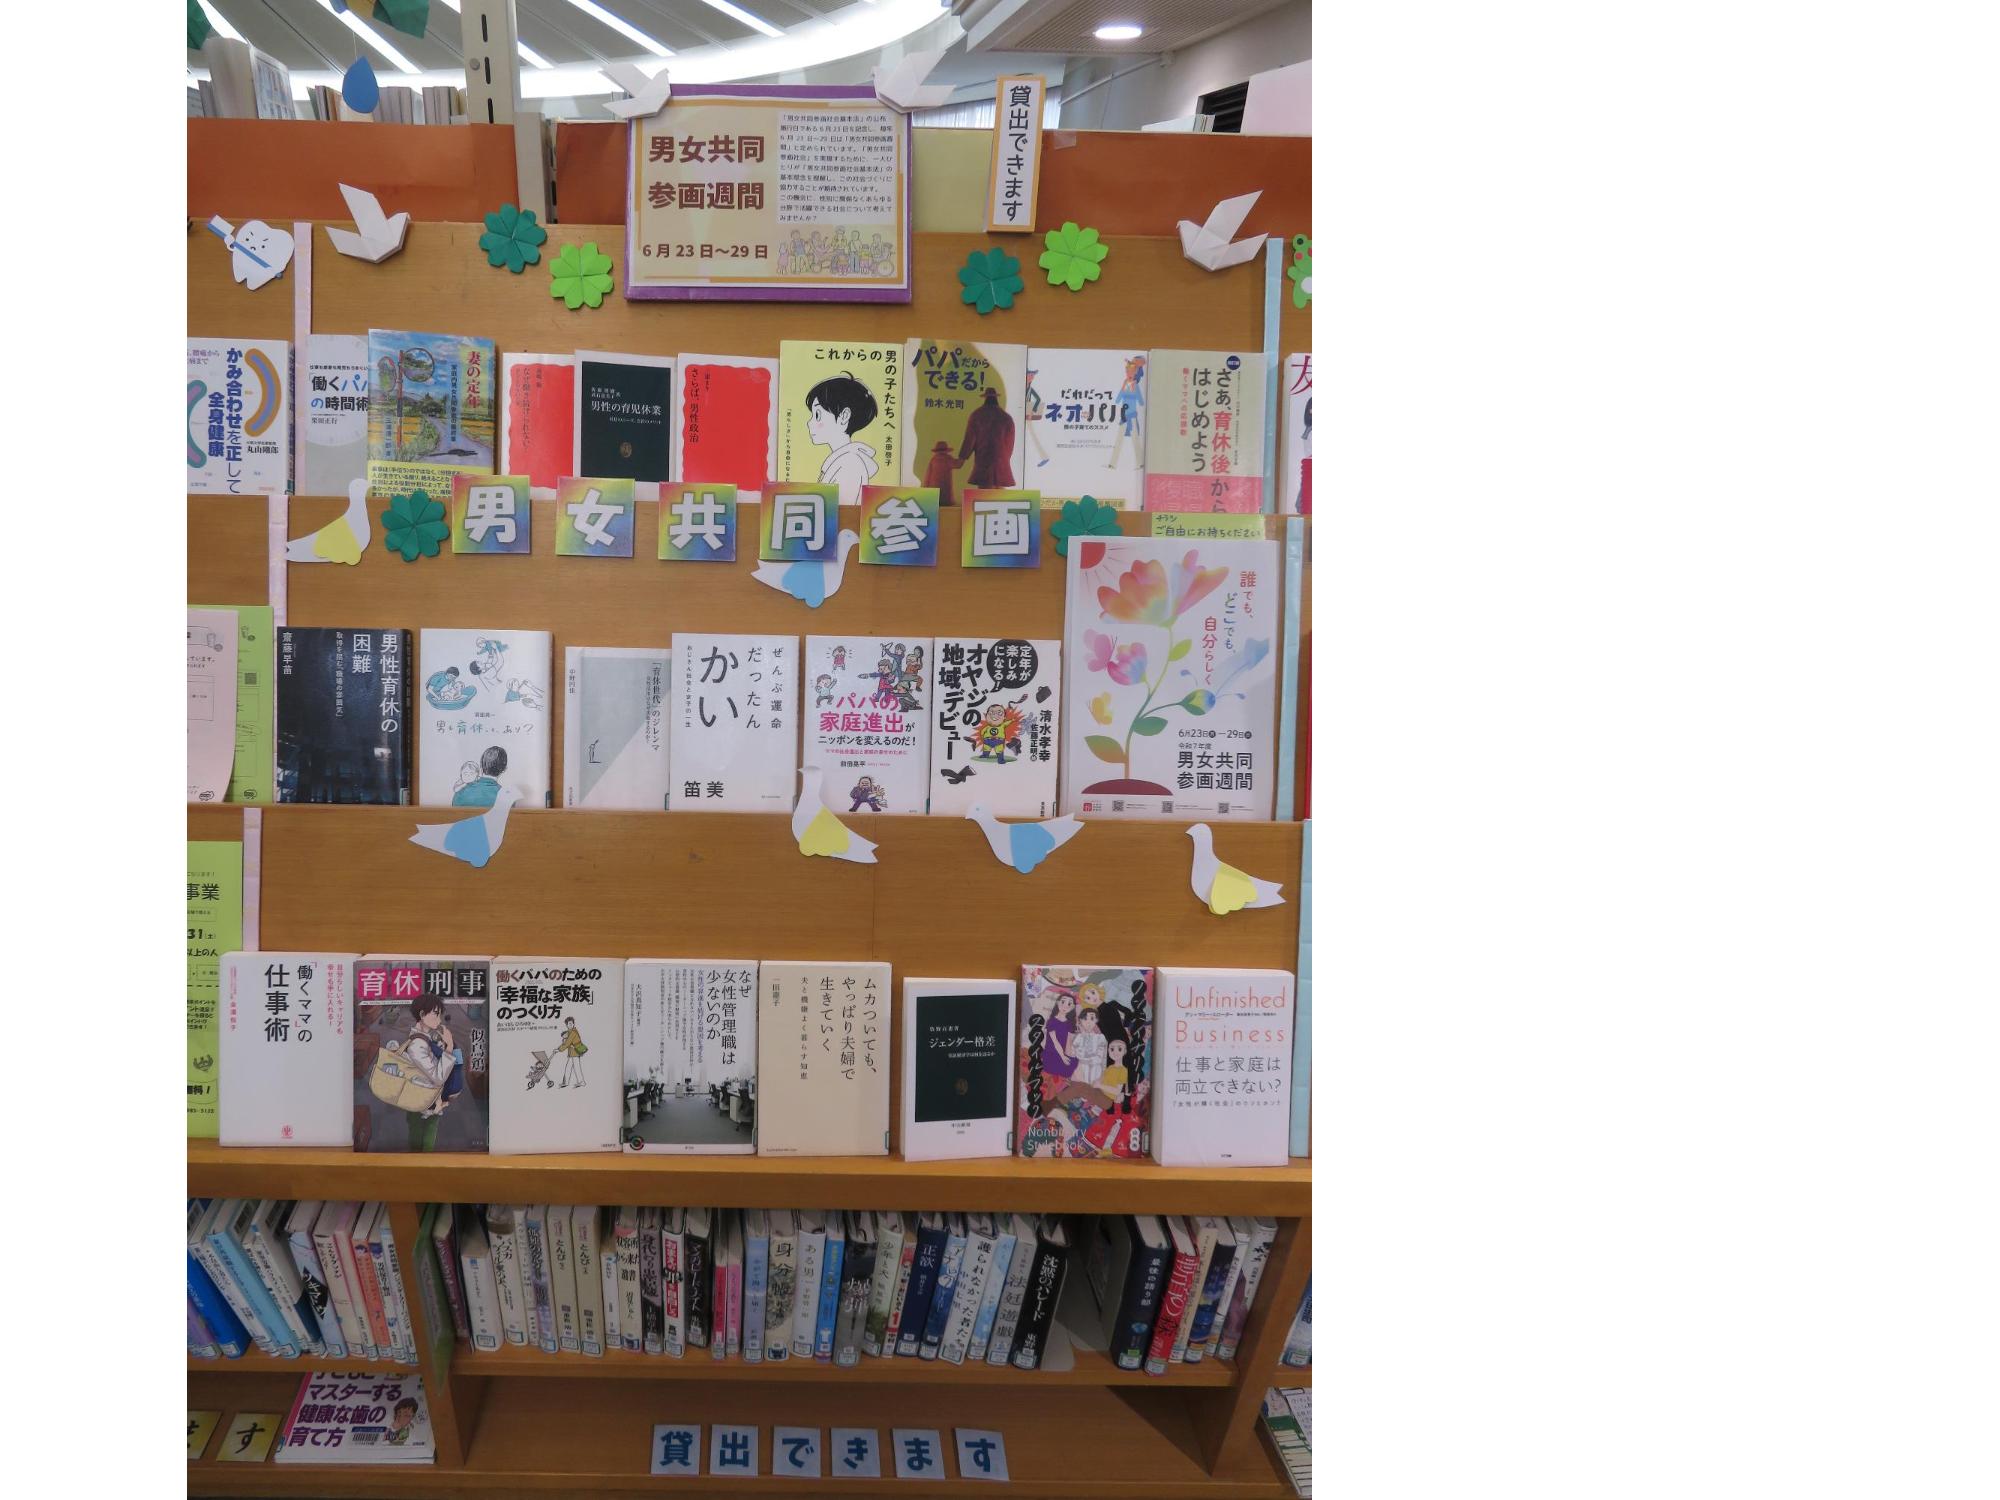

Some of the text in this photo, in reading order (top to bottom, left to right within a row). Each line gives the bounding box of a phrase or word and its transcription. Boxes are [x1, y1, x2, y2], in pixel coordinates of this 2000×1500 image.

[649, 135, 765, 164] 男女共同
[1002, 85, 1032, 222] 貸出できます
[648, 182, 764, 210] 参画週間
[814, 348, 882, 361] これからの
[911, 346, 990, 369] パパだから
[466, 351, 481, 408] 妻の定年
[882, 350, 897, 430] 男の子たちへ
[1061, 389, 1113, 400] だれだって
[225, 347, 243, 494] かみ合わせを正して
[591, 400, 662, 416] 男性の育児休業
[689, 368, 699, 443] さらば、男性政治
[924, 398, 964, 410] 鈴木光司
[1045, 403, 1129, 423] ネオパパ
[1191, 367, 1212, 473] はじめよう
[208, 391, 225, 457] 全身健康
[884, 436, 893, 467] 太田啓子
[464, 484, 1032, 556] 男女共同参画
[1155, 525, 1261, 538] ご自由にお持ちください
[1156, 514, 1178, 522] チラシ
[1239, 571, 1257, 619] 誰でも、
[1224, 592, 1238, 652] どこでも、
[352, 633, 372, 674] 困難
[1006, 645, 1019, 680] 楽しみ
[1019, 645, 1032, 681] 定年が
[1201, 616, 1218, 685] 自分らしく
[379, 633, 400, 734] 男性育休の
[699, 646, 739, 728] かい
[746, 647, 762, 729] だったん
[770, 647, 784, 729] ぜんぶ運命
[836, 692, 901, 710] パパの
[962, 643, 988, 726] オヤジの
[939, 643, 967, 761] 地域デビュー
[819, 711, 915, 733] 家庭進出が
[1038, 710, 1052, 762] 清水孝幸
[1177, 751, 1252, 770] 男女共同
[684, 780, 724, 798] 笛美
[1177, 771, 1253, 790] 参画週間
[360, 970, 486, 998] 育休刑事
[496, 968, 602, 984] 働くパパのための
[737, 969, 752, 999] なぜ
[264, 963, 290, 1043] 仕事術
[497, 985, 594, 1005] 「幸福な家族」
[497, 1005, 562, 1019] のつくり方
[706, 969, 721, 1040] 少ないのか
[1176, 986, 1286, 1009] Unfinished
[721, 969, 737, 1066] 女性管理職は
[819, 976, 834, 1052] 生きていく
[840, 976, 856, 1081] やっぱり夫婦で
[863, 977, 877, 1074] ムカついても、
[1176, 1020, 1285, 1042] Business
[929, 1035, 996, 1049] ジェンダー格差
[1176, 1056, 1281, 1073] 仕事と家庭は
[1033, 1253, 1059, 1322] 沈黙のパレード
[308, 1384, 402, 1401] マスターする
[297, 1405, 386, 1424] 健康な歯の
[289, 1427, 346, 1447] 育て方
[660, 1431, 996, 1472] 貸出できます
